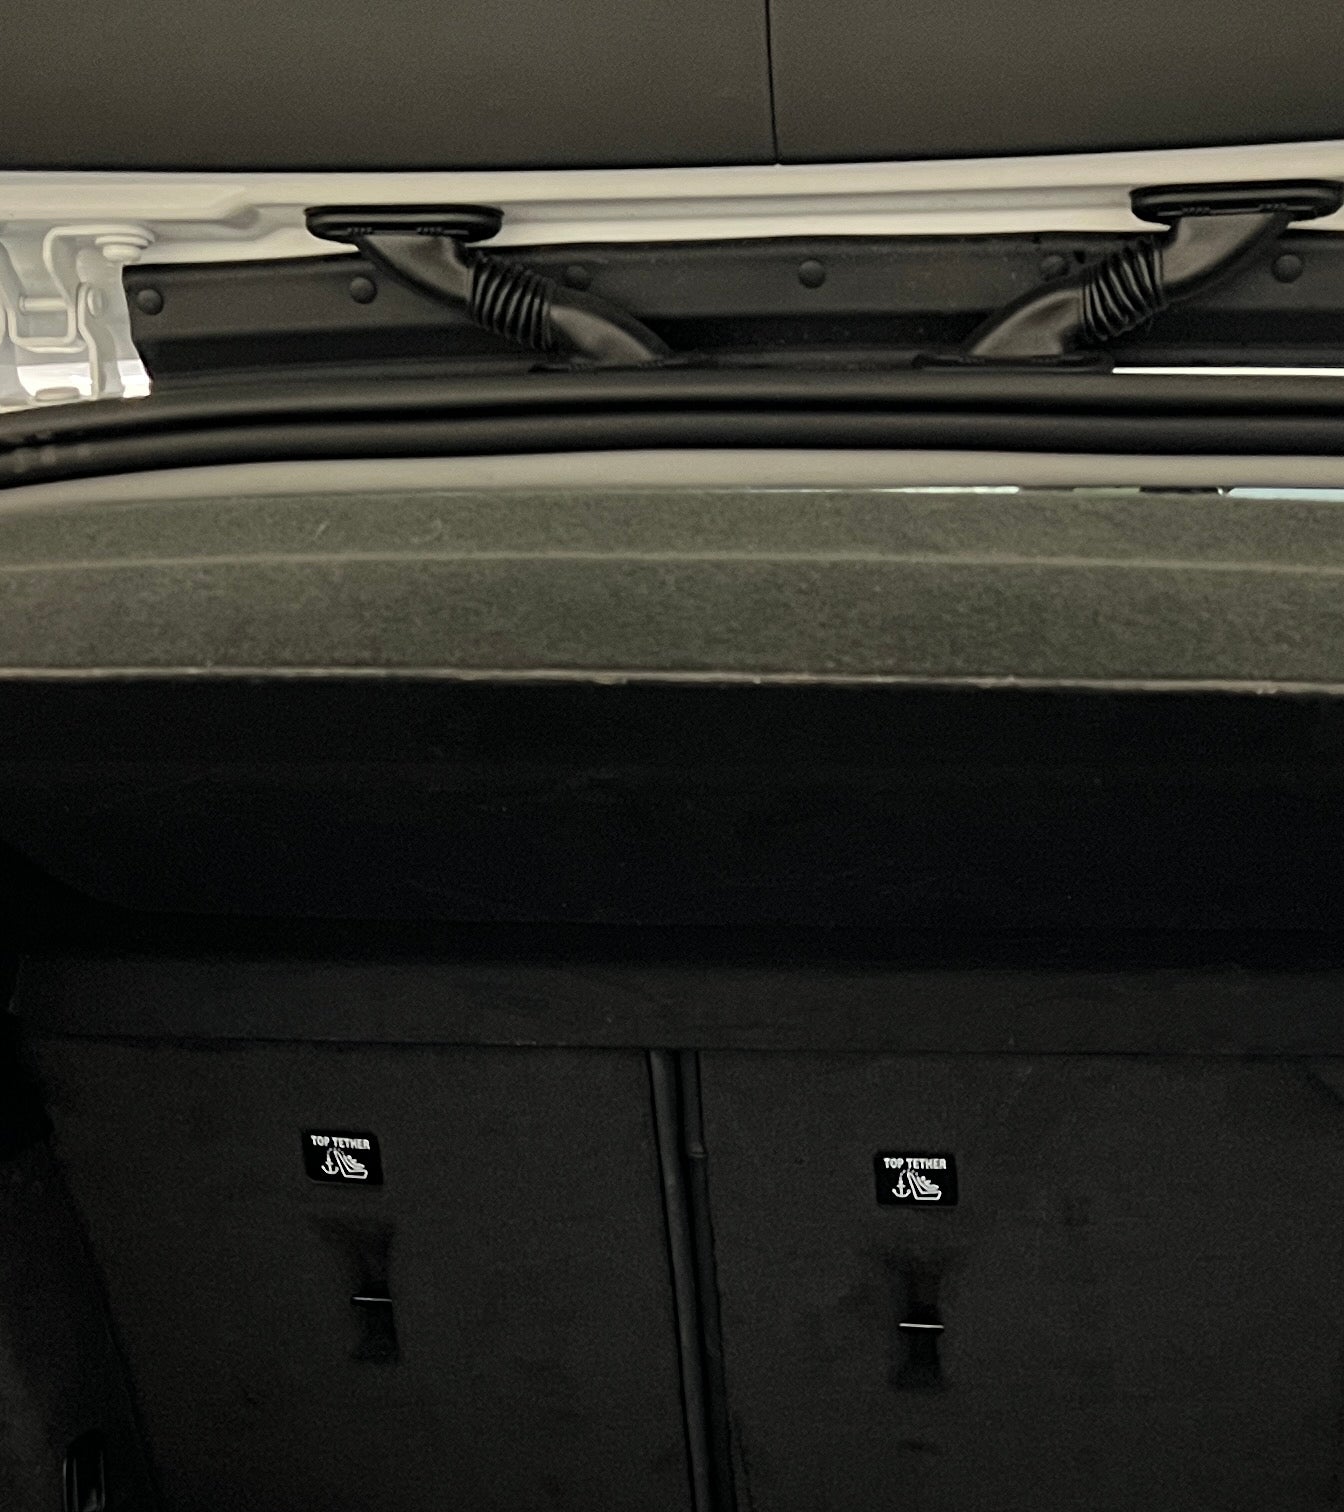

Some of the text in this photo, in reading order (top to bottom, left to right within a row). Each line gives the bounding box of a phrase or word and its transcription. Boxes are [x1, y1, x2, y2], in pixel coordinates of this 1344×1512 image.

[310, 1135, 371, 1150] TOP TETHER
[883, 1157, 947, 1169] TOP TETHER
